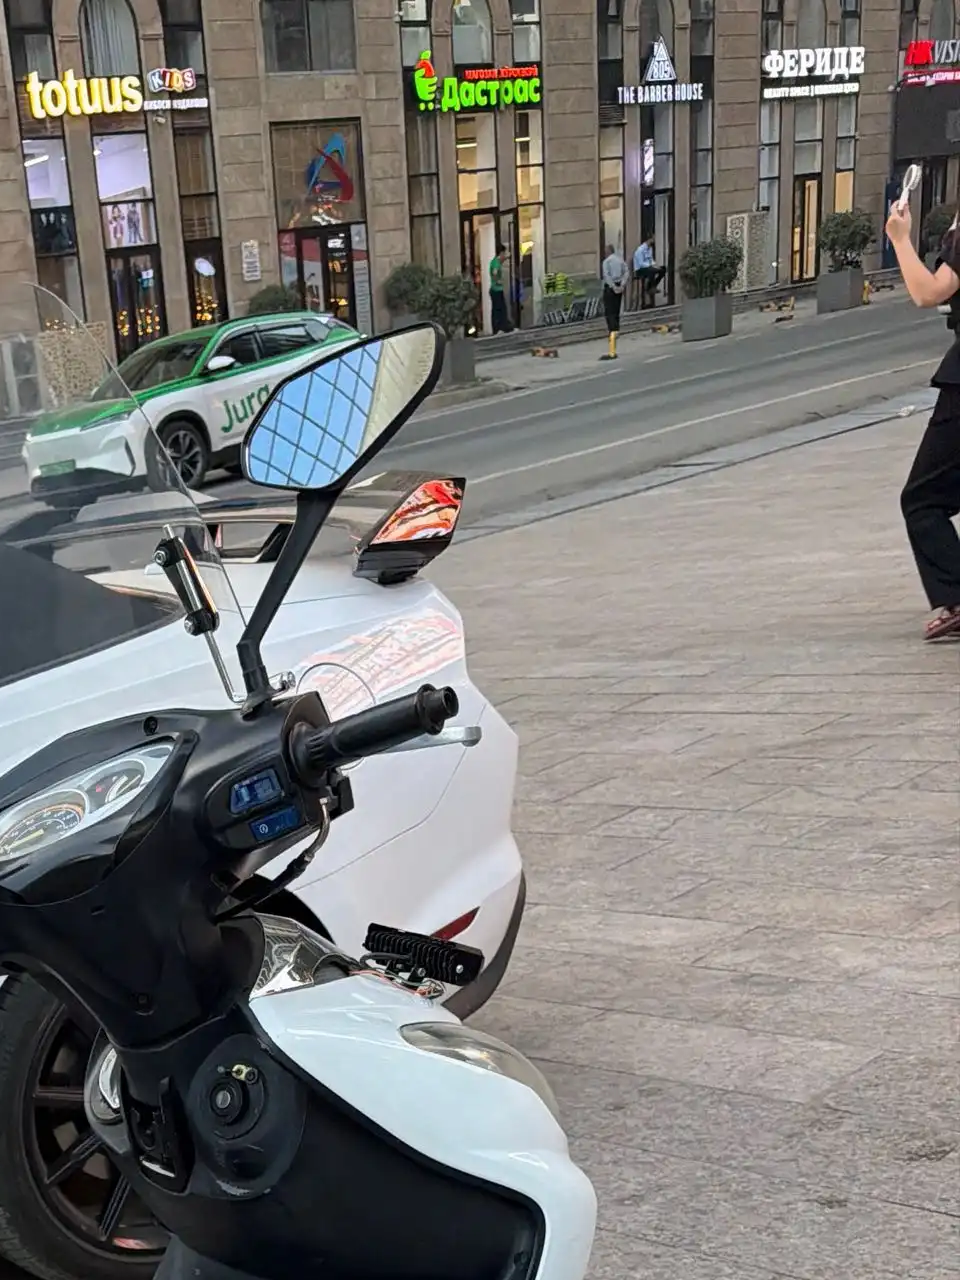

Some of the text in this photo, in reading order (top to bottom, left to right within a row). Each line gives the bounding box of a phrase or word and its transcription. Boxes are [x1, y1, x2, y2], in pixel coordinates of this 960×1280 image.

[764, 46, 865, 80] ФЕРИДЕ
[905, 39, 960, 65] HIKVISI
[26, 69, 143, 119] totuus
[150, 68, 196, 91] KIDS
[441, 77, 540, 112] Дастрас
[617, 83, 703, 104] THE BARBER HOUSE
